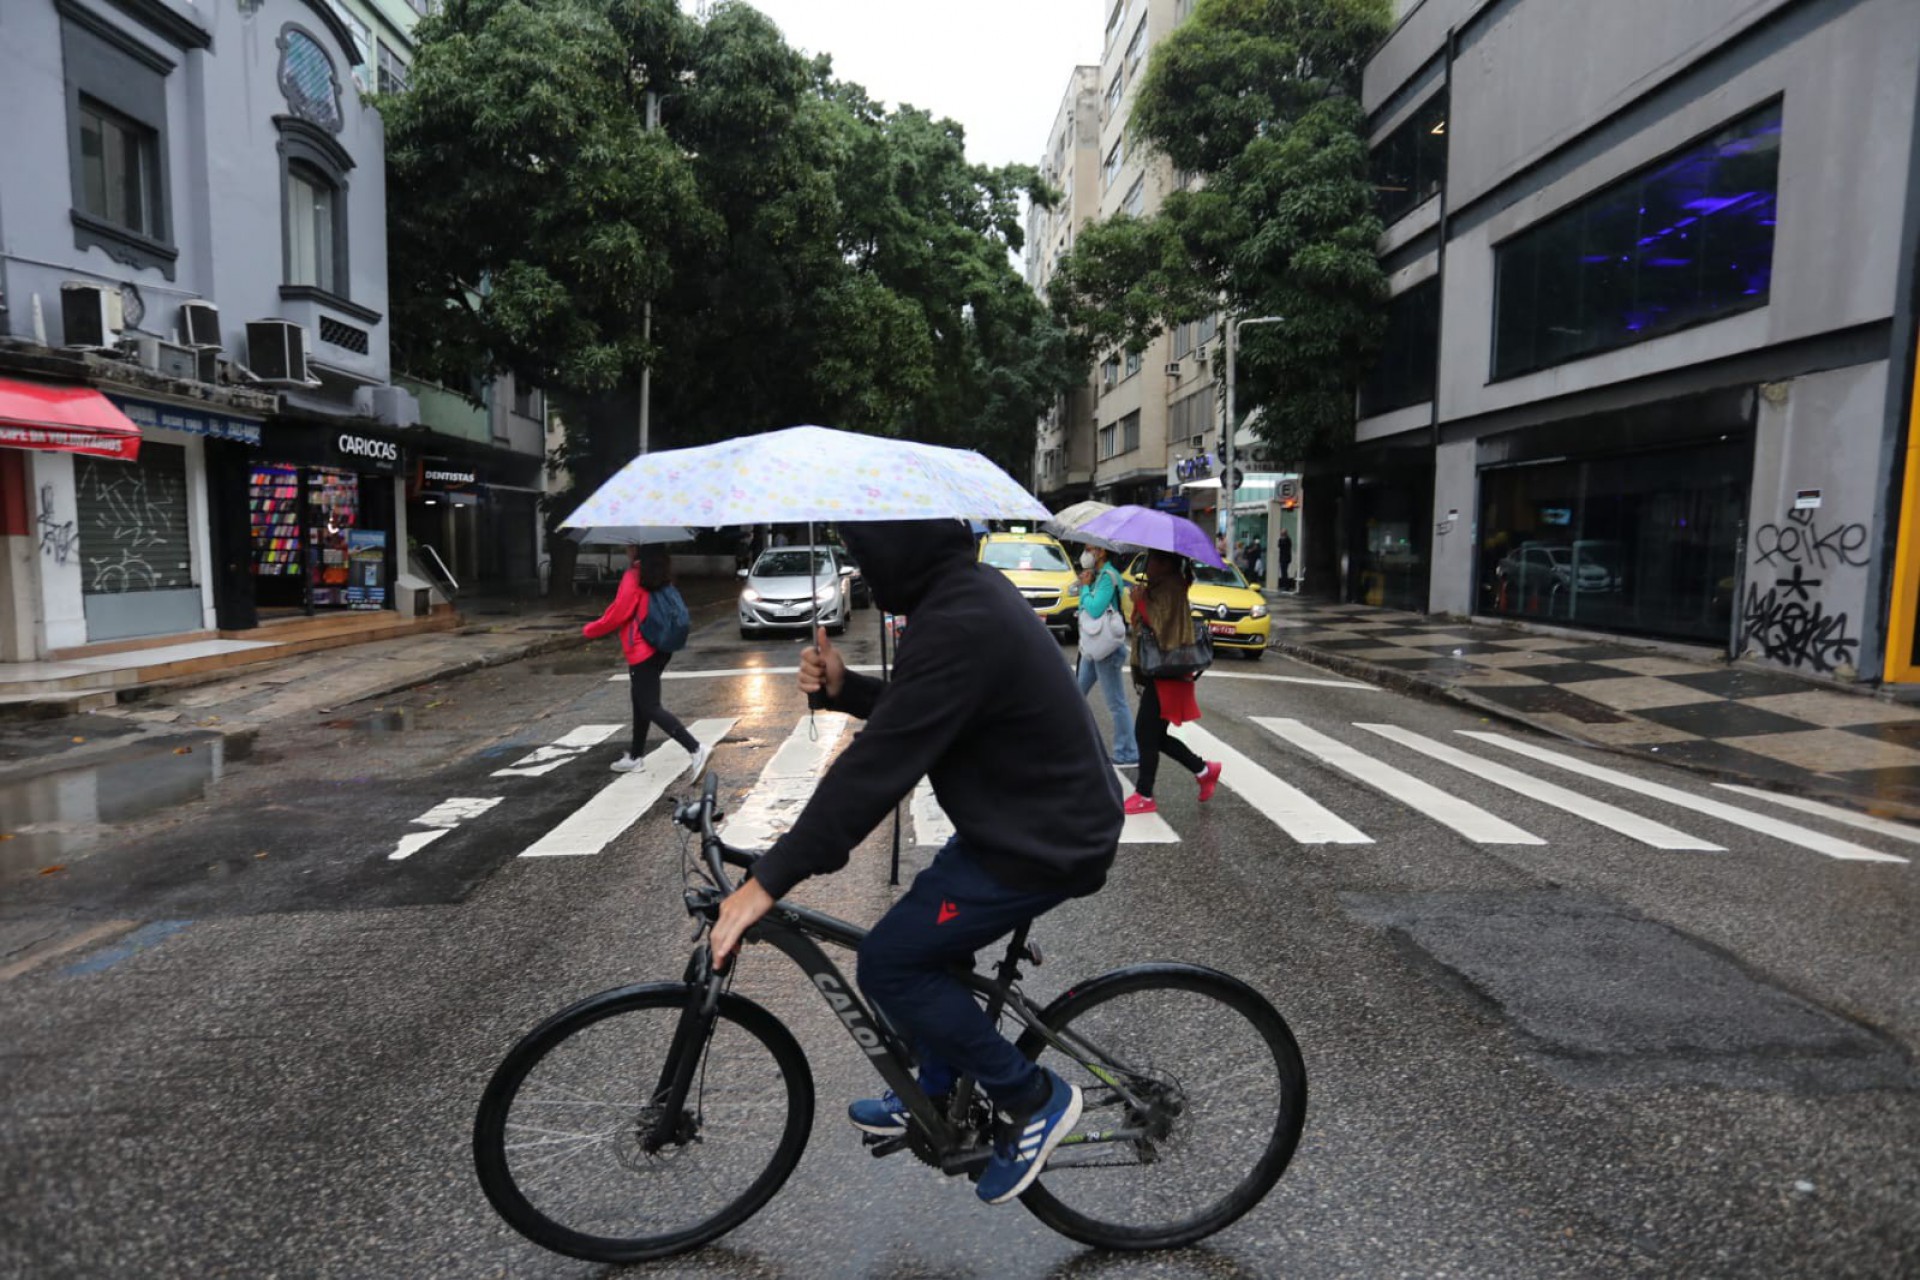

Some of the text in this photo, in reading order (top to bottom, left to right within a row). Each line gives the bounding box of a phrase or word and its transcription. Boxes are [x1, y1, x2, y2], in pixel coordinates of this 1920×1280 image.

[338, 434, 398, 461] CARIOCAS
[425, 470, 475, 483] DENTISTAS
[813, 972, 888, 1056] CALOI
